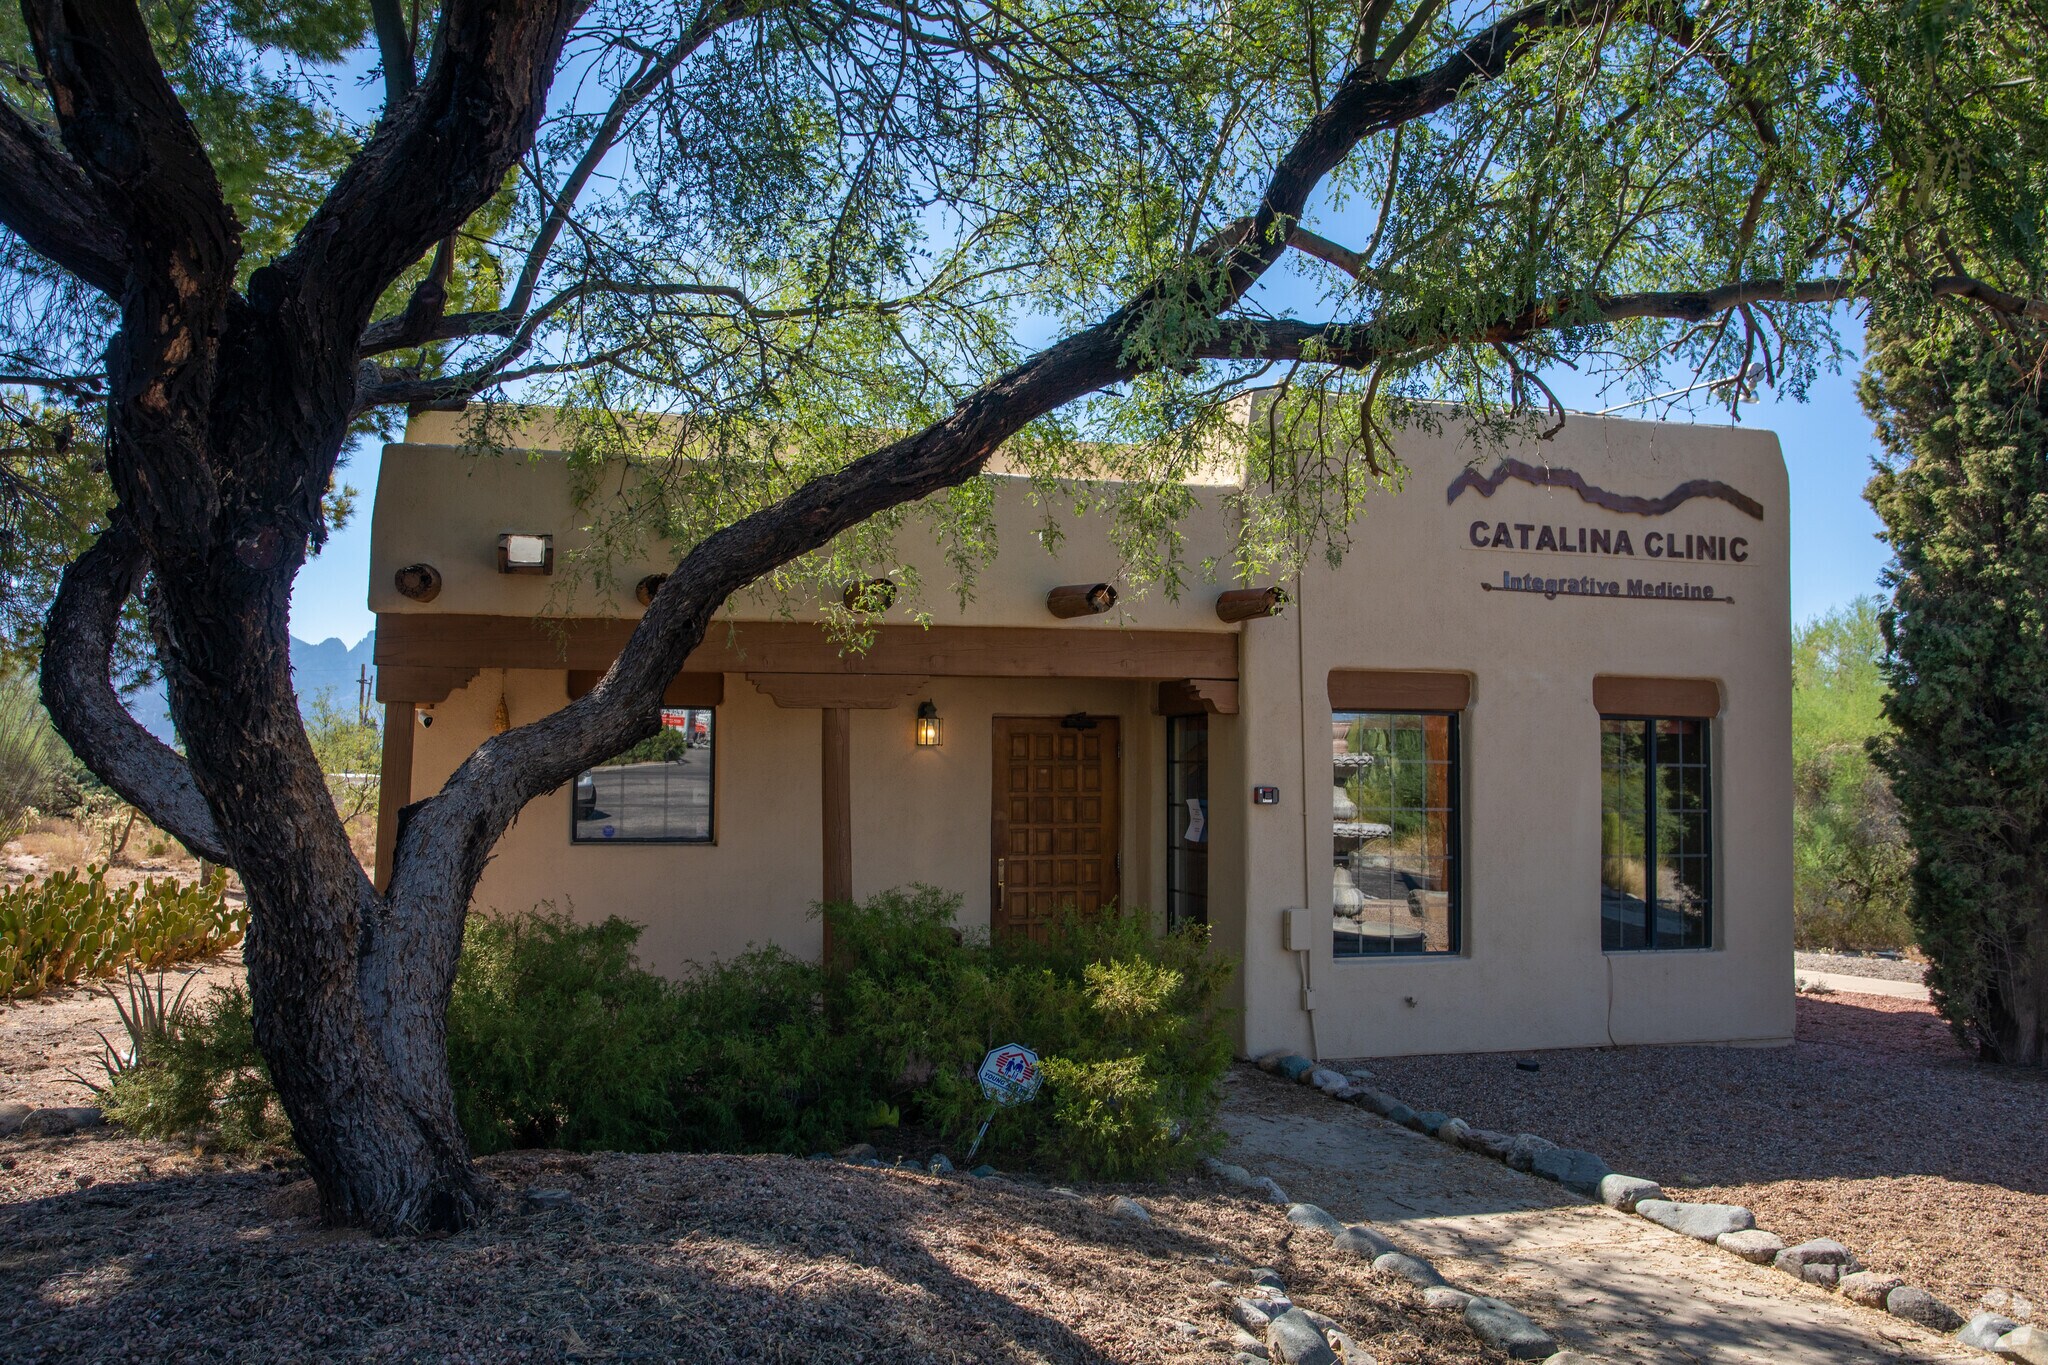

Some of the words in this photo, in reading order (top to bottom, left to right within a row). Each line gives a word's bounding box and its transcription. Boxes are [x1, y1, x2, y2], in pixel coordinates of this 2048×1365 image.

[1469, 520, 1635, 556] CATALINA
[1644, 532, 1749, 562] CLINIC
[1503, 571, 1620, 600] Integrative
[1627, 579, 1714, 599] Medicine
[984, 1072, 1006, 1086] YOUNG
